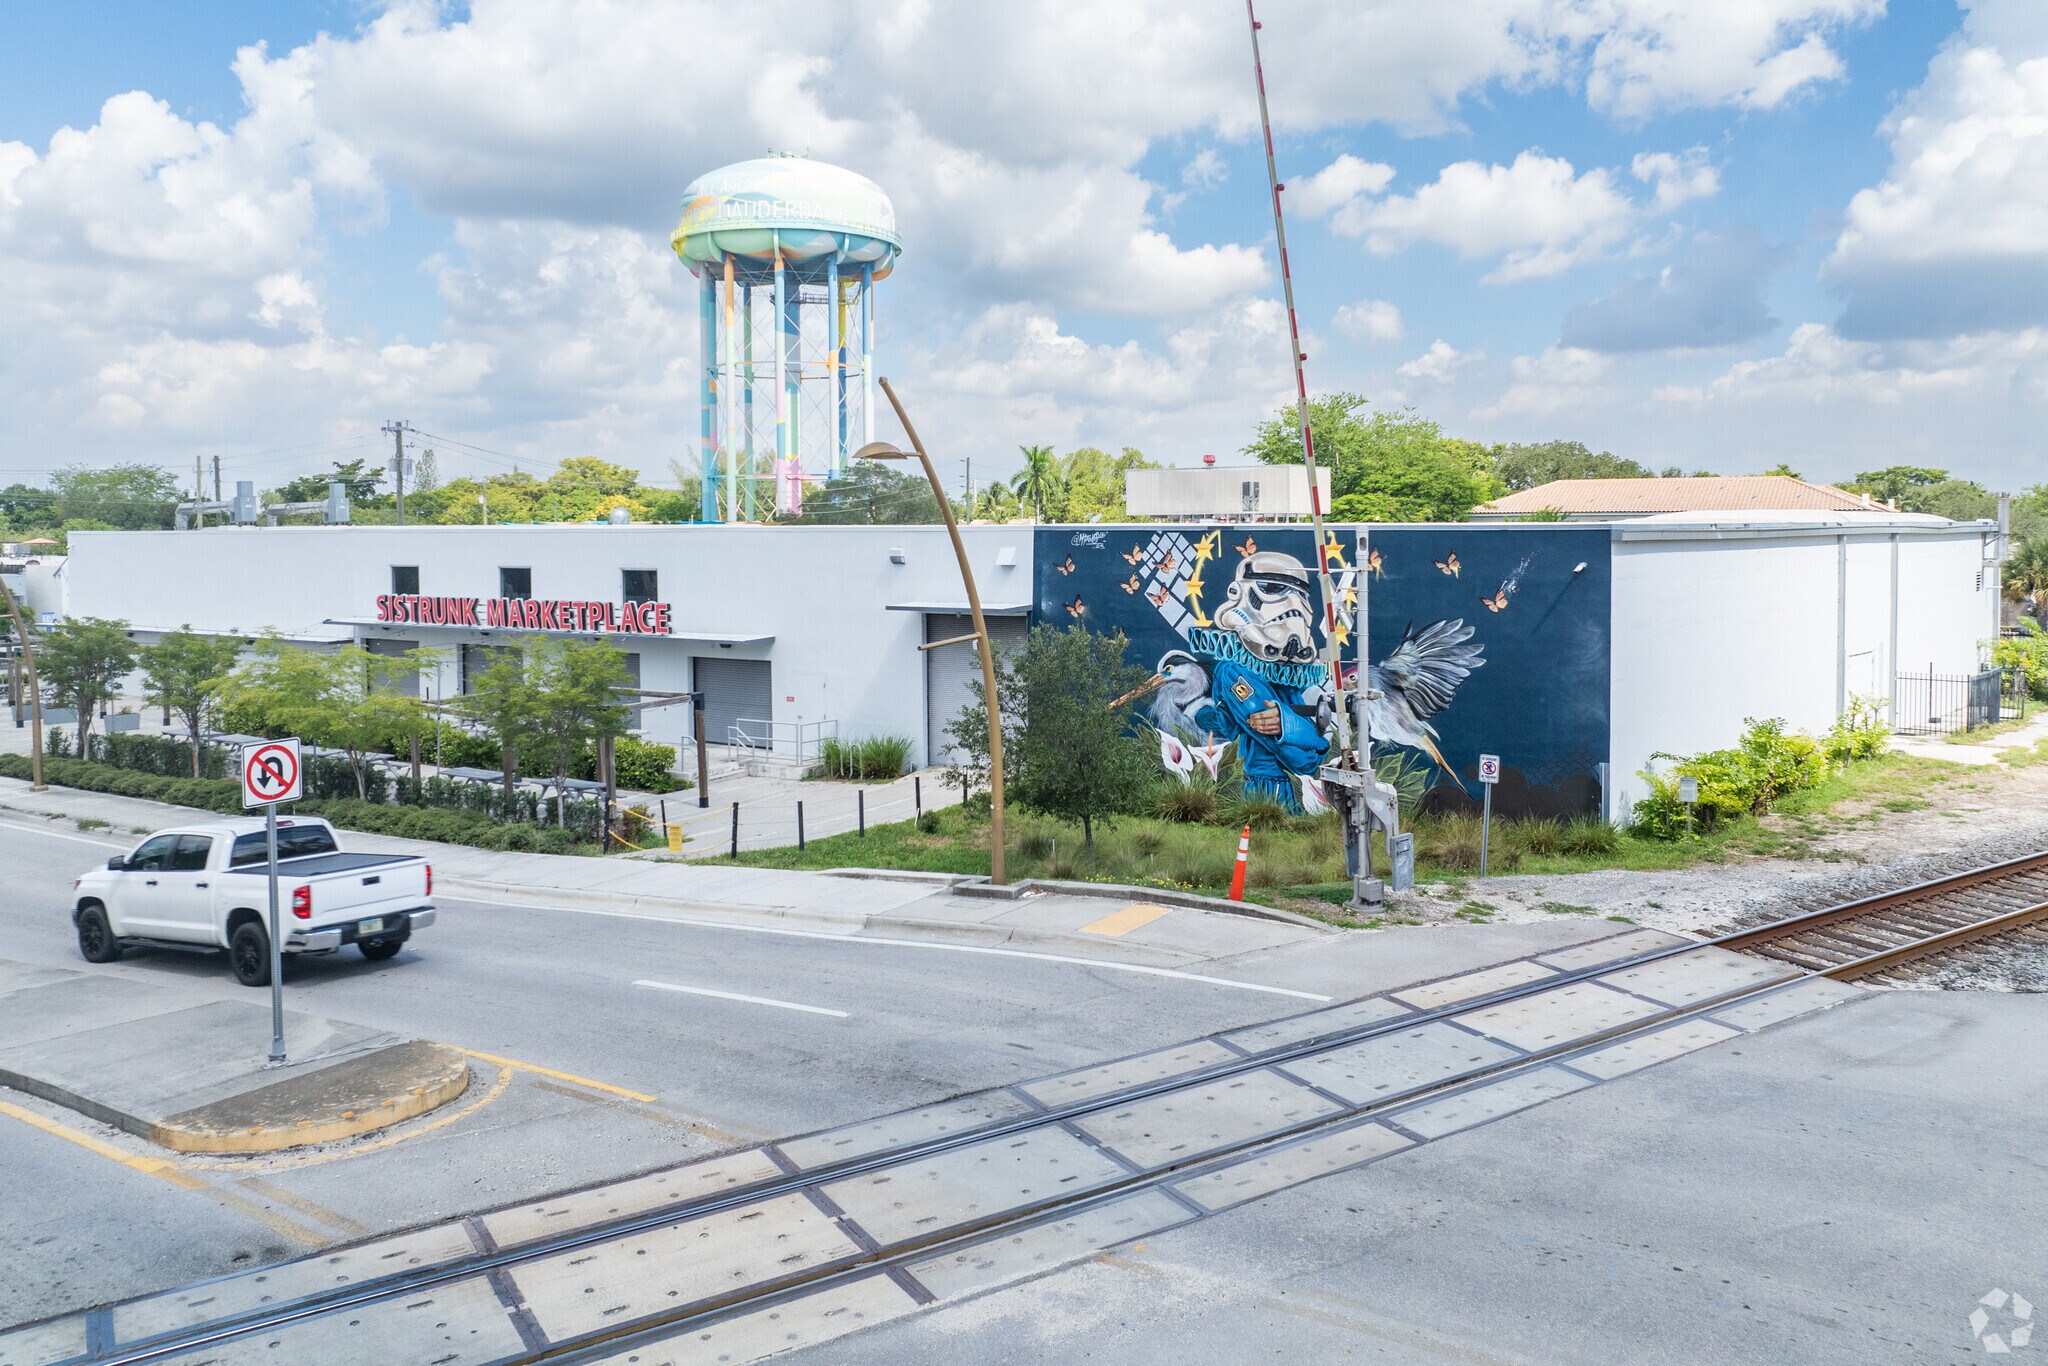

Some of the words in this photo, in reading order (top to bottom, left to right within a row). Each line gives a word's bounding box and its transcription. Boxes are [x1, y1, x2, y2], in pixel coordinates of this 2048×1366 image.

[718, 198, 848, 222] LAUDERDALE
[376, 595, 478, 626] SISTRUNK
[486, 598, 670, 634] MARKETPLACE
